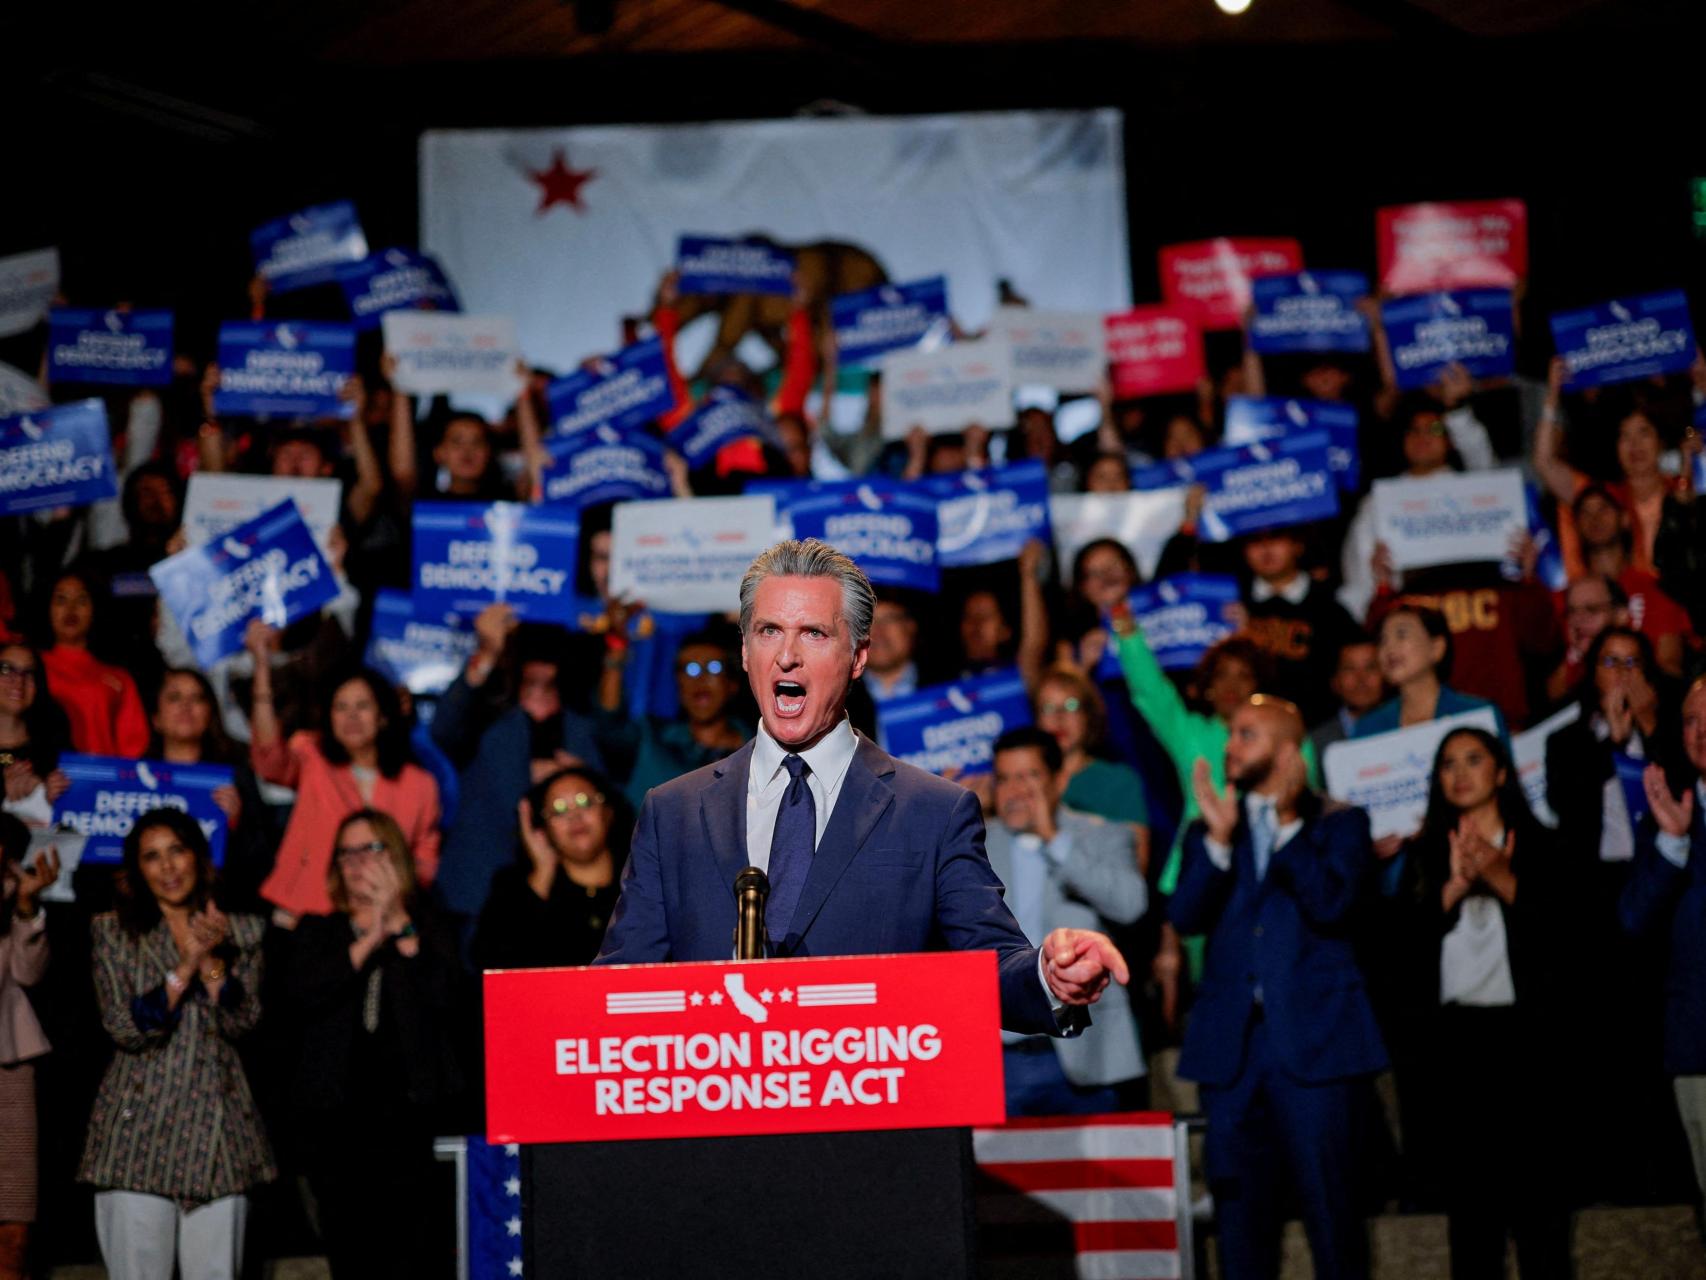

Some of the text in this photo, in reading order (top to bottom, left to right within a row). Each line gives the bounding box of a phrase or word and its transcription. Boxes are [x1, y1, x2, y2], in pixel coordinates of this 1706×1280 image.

[0, 454, 102, 491] MOCRACY
[62, 811, 215, 840] DEMOY
[555, 1023, 942, 1075] ELECTION RIGGING
[595, 1067, 905, 1116] RESPONSE ACT
